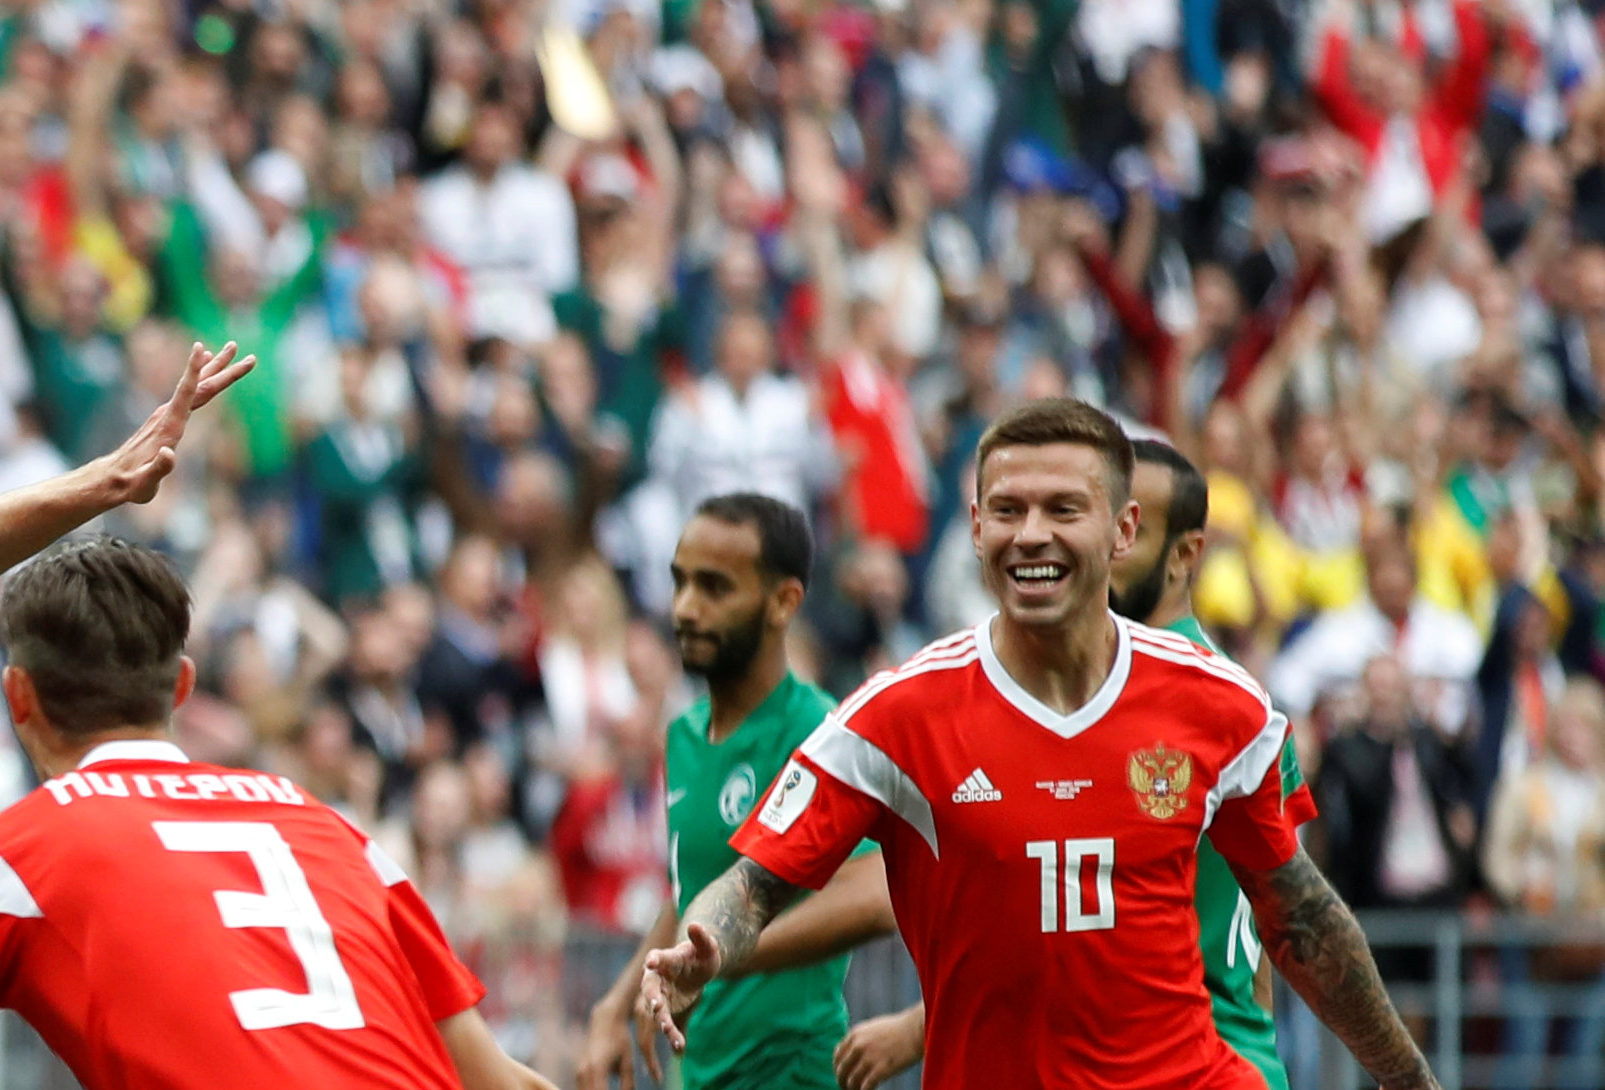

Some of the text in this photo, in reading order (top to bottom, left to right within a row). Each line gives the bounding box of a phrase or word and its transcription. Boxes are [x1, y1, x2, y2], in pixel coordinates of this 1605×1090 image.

[951, 790, 1003, 804] adidas
[151, 820, 366, 1030] 3
[1026, 838, 1115, 933] 10
